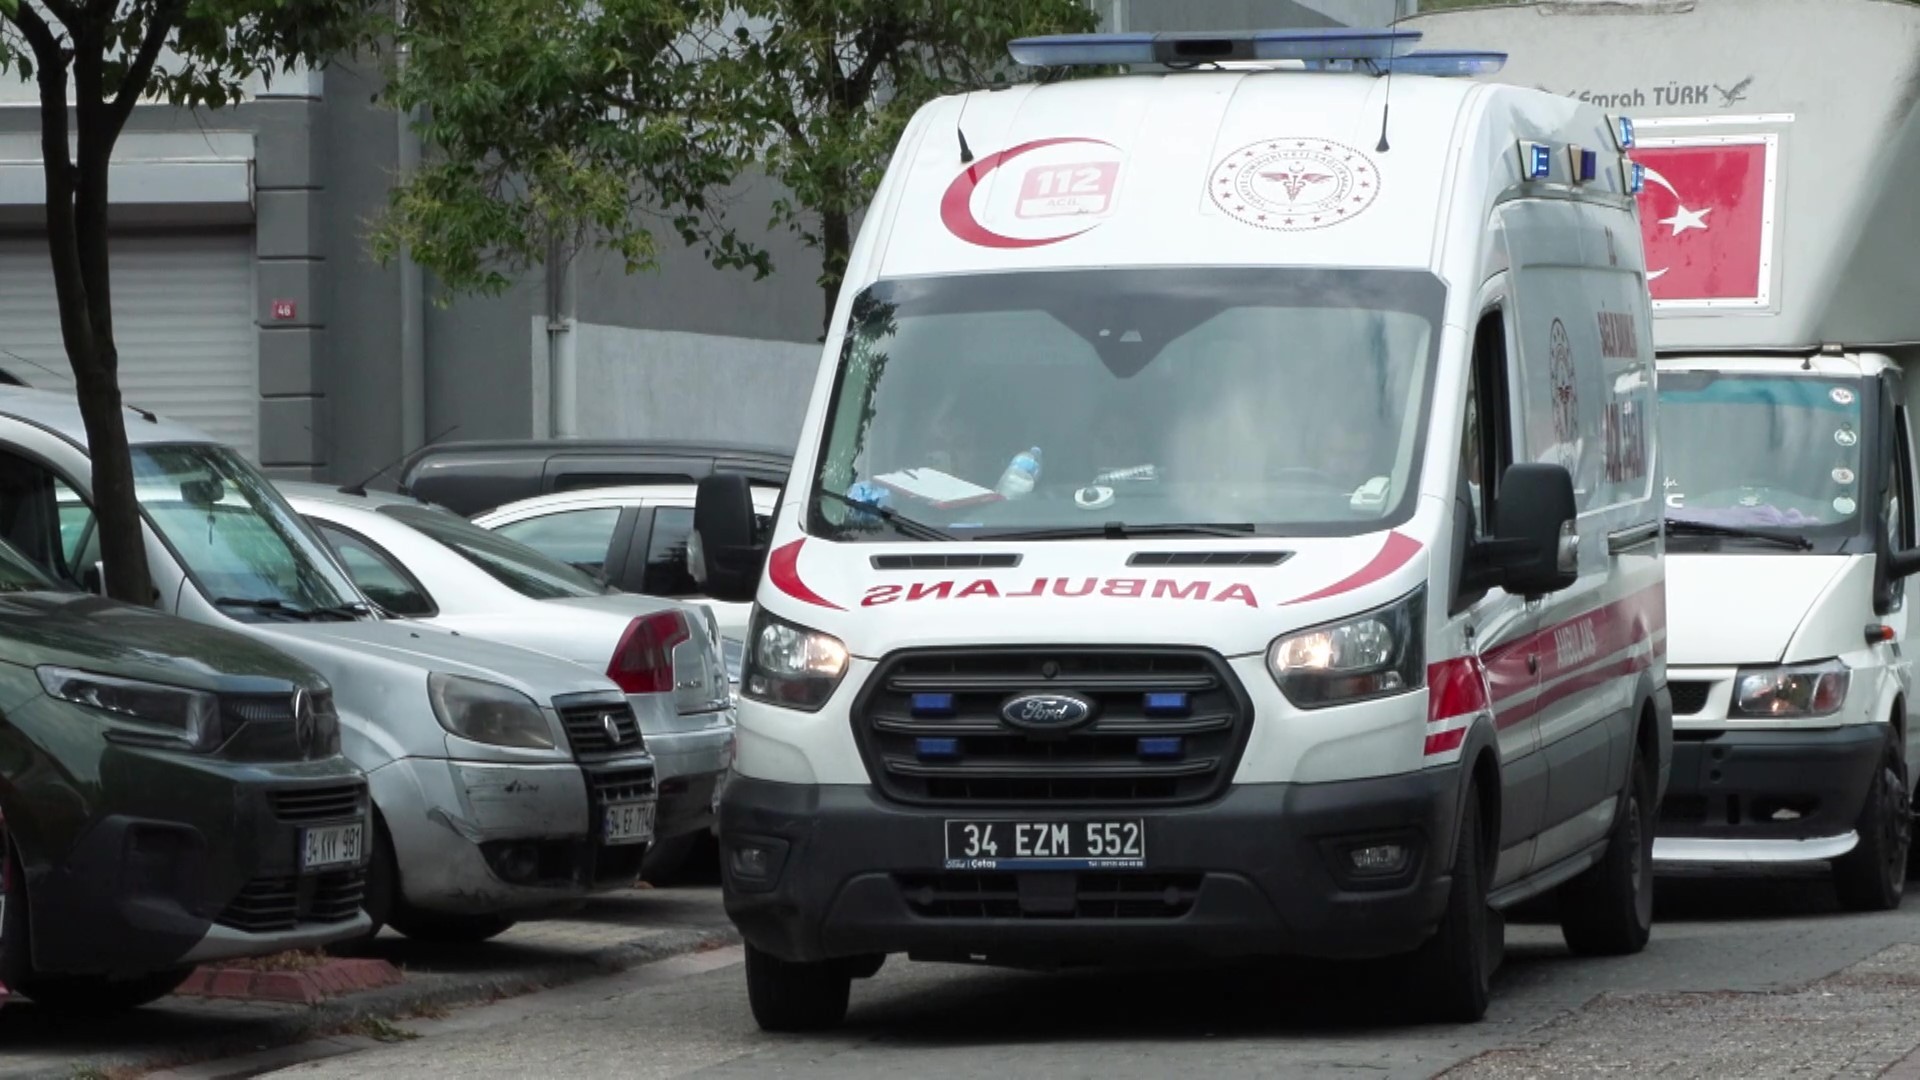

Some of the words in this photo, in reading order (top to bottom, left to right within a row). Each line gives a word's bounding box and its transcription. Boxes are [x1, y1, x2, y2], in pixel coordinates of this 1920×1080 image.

[1652, 81, 1709, 106] TÜRK
[1037, 166, 1102, 196] 112
[1021, 700, 1069, 720] Ford
[307, 832, 318, 863] 34
[342, 827, 361, 858] 981
[964, 824, 998, 856] 34
[1015, 823, 1070, 856] EZM
[1086, 822, 1140, 855] 552
